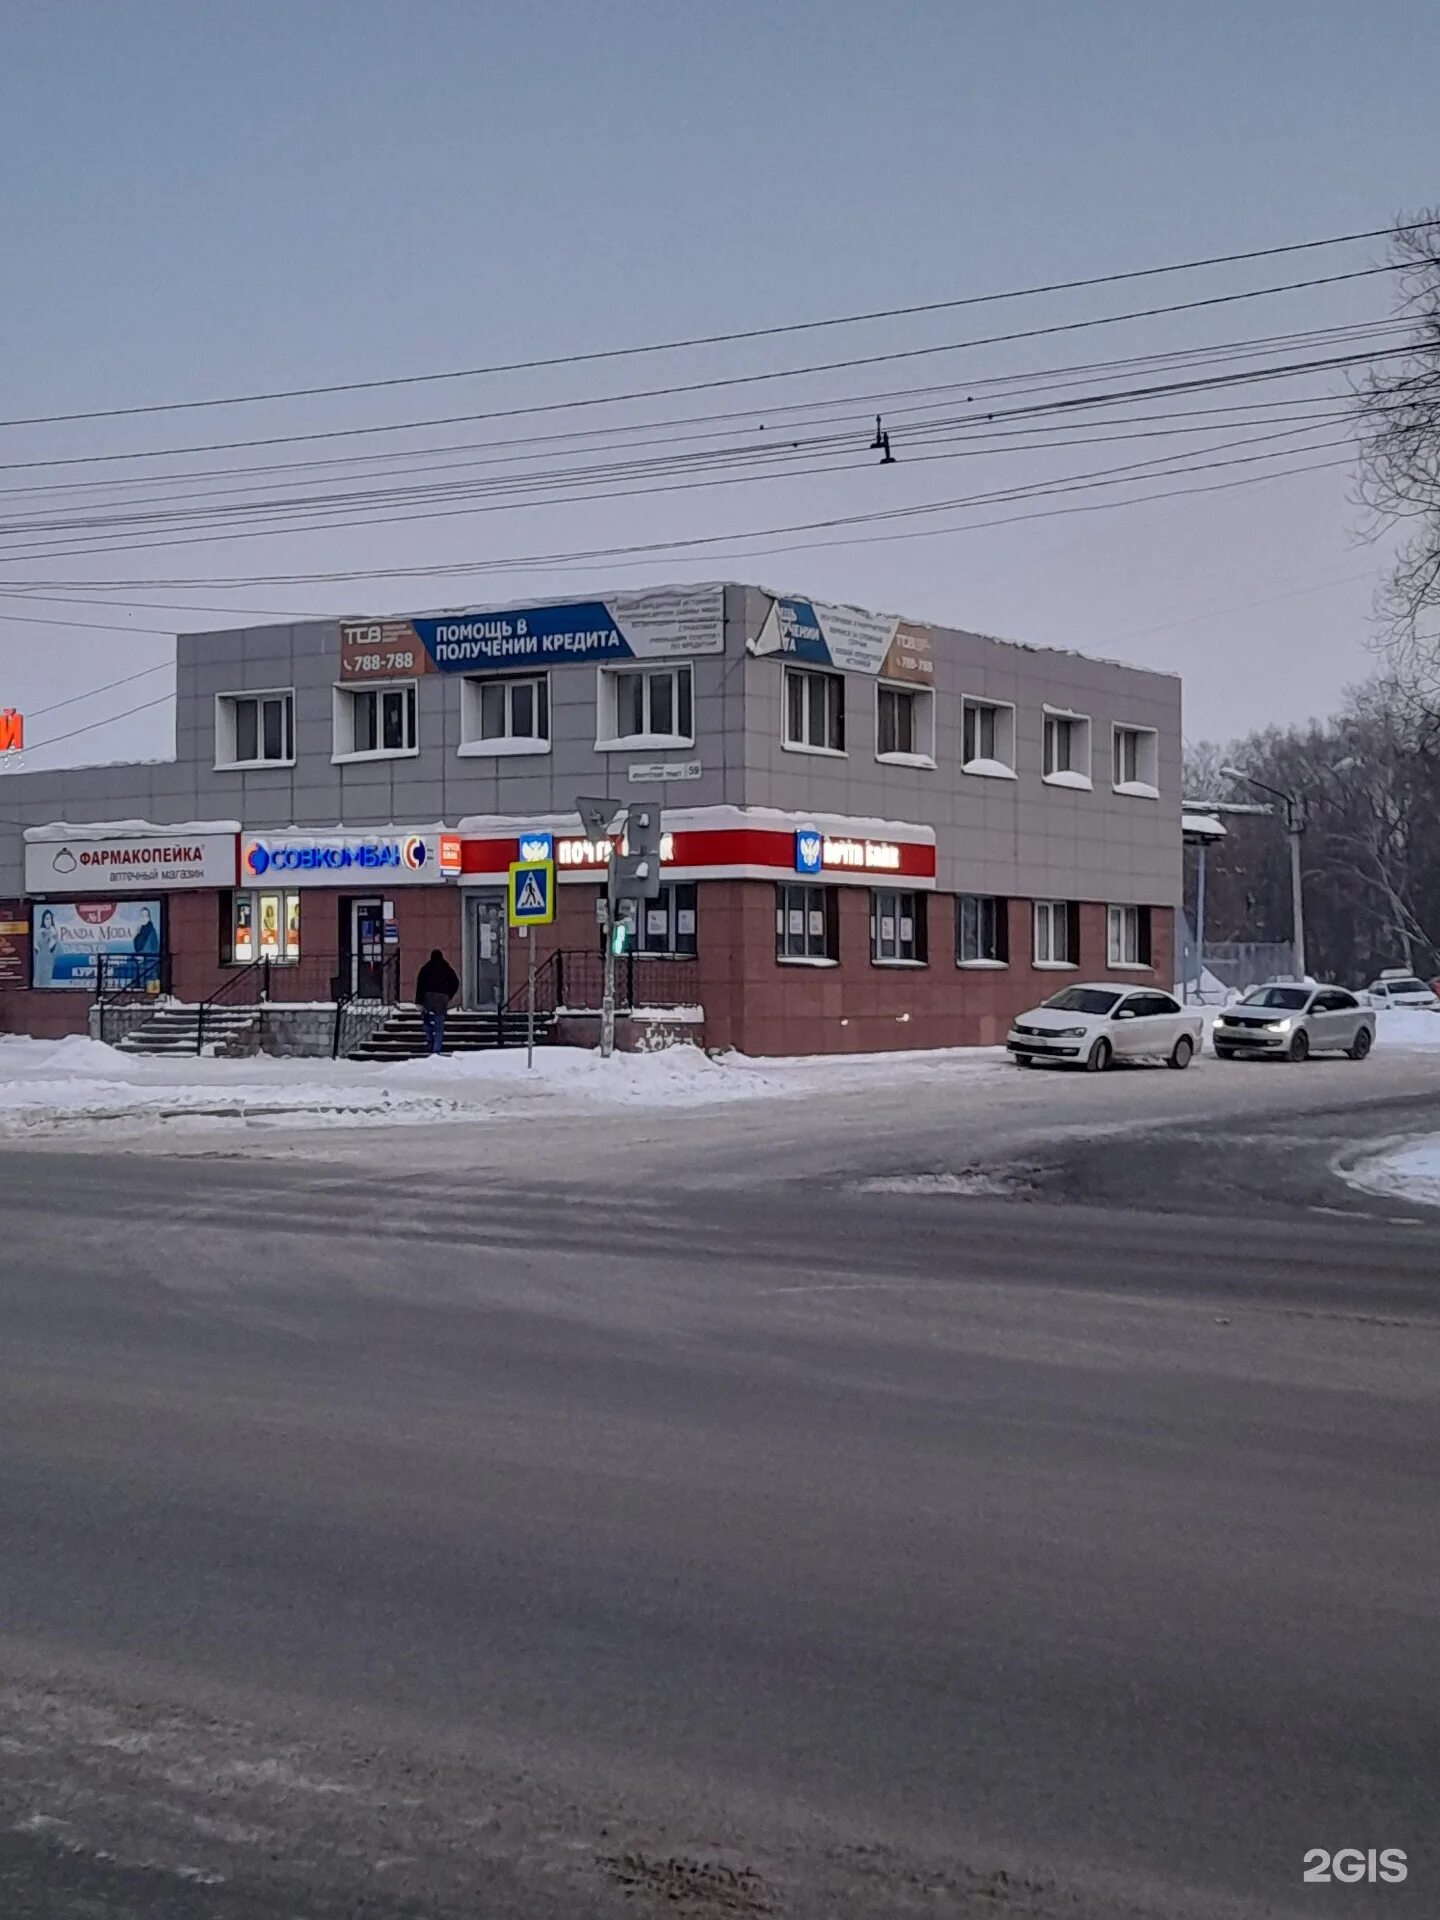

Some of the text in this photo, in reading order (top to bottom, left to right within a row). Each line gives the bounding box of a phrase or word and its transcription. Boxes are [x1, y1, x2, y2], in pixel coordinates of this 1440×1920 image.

[436, 619, 512, 643] ПОМОЩЬ
[516, 618, 527, 635] В
[436, 629, 620, 661] ПОЛУЧЕНИИ КРЕДИТА
[353, 652, 413, 672] 788-788
[79, 844, 203, 866] ФАРМАКОПЕЙКА
[110, 868, 205, 882] аптечный магазин
